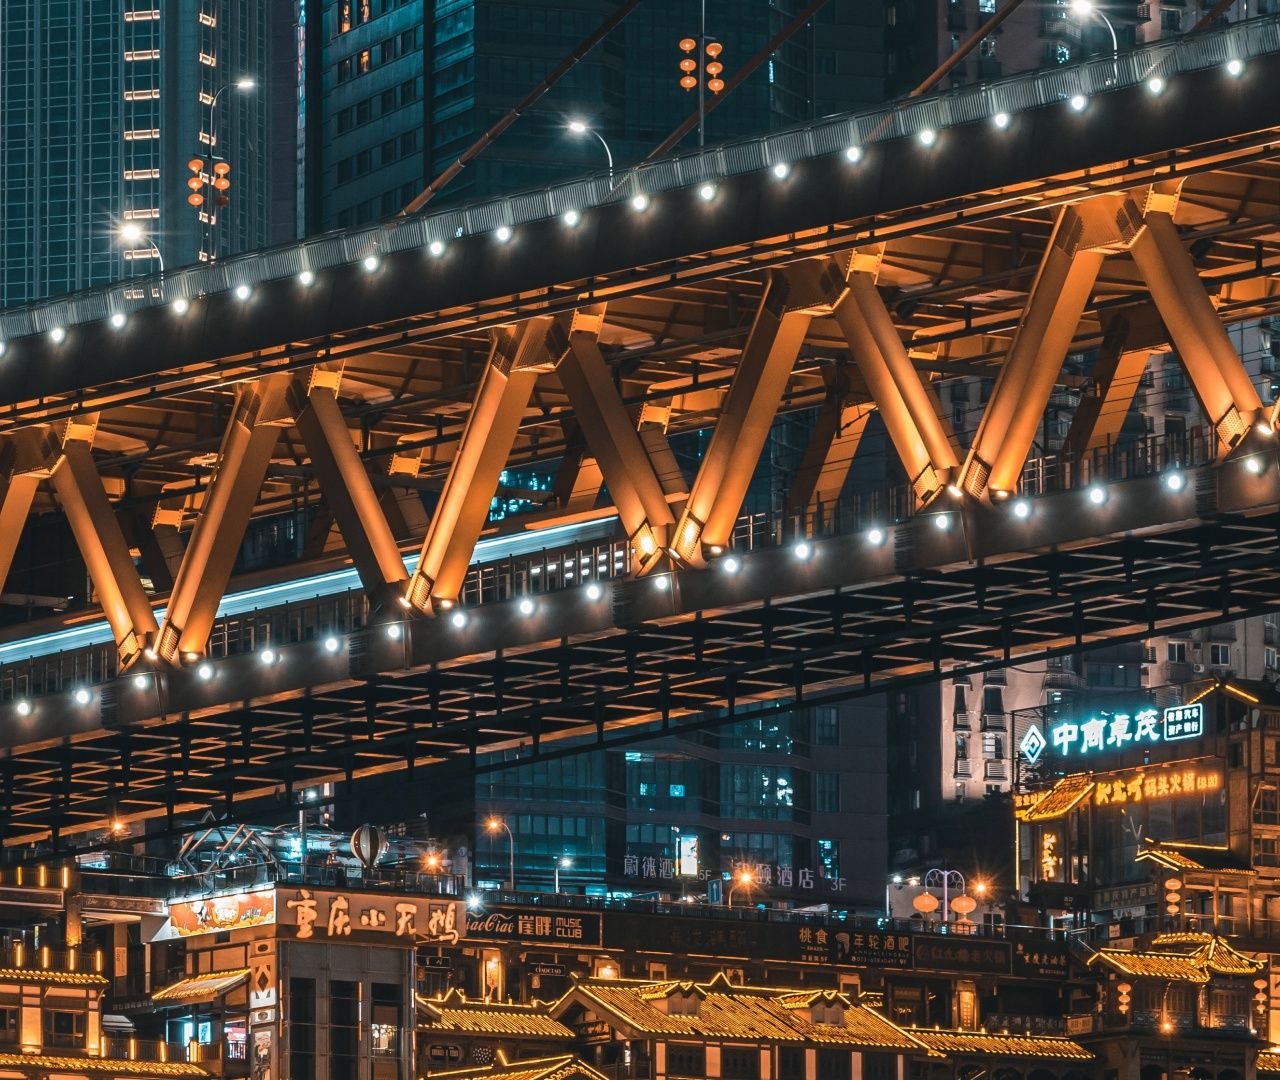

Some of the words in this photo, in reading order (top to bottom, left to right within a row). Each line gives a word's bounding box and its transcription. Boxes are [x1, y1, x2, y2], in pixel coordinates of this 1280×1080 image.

[1052, 709, 1160, 756] 中商卓茂
[830, 877, 847, 892] 3F
[286, 889, 459, 945] 重庆小天鹅
[466, 912, 514, 934] iaoCiao
[556, 917, 582, 928] MUSIC
[556, 928, 582, 938] CLUB
[854, 933, 909, 952] 年轮酒吧
